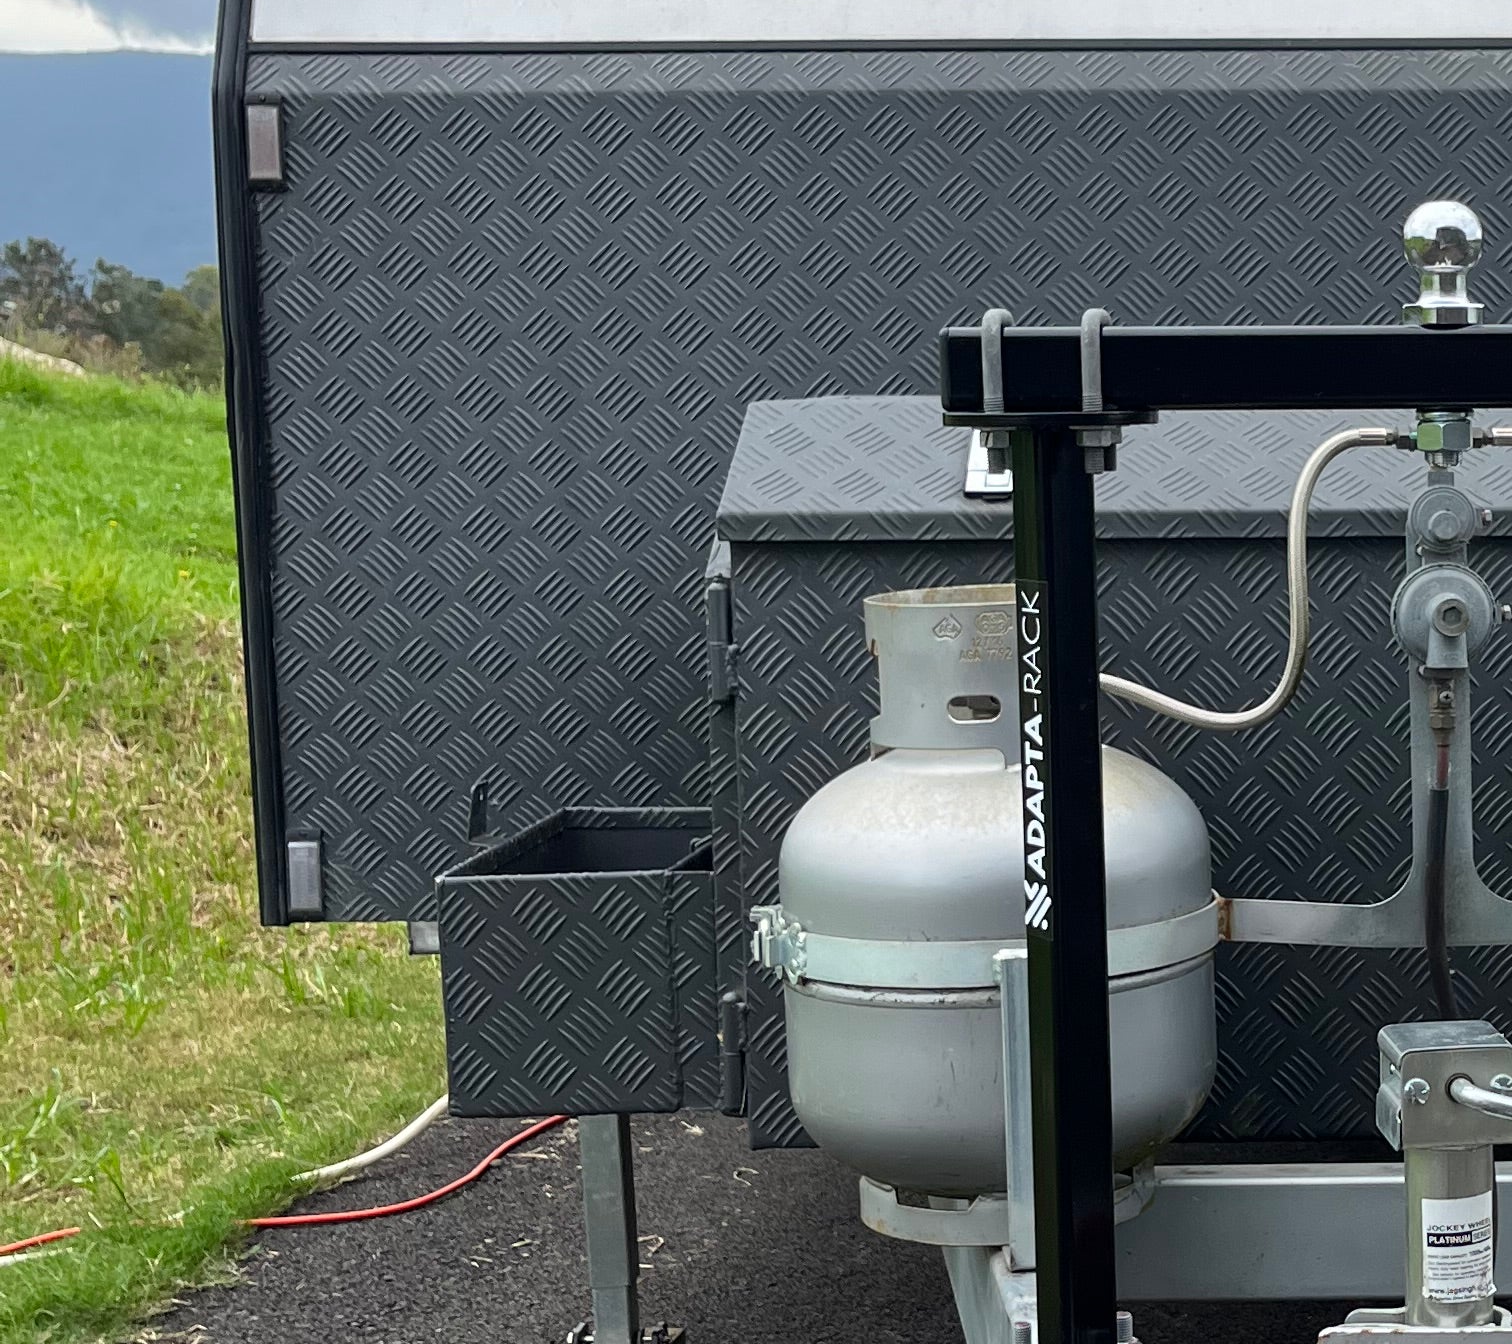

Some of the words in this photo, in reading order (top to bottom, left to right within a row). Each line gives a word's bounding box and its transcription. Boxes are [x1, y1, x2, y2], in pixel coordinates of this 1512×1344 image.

[1021, 590, 1047, 880] ADAPTA-RACK
[1426, 1222, 1465, 1232] JOCKEY
[1428, 1234, 1471, 1244] PLATINUM
